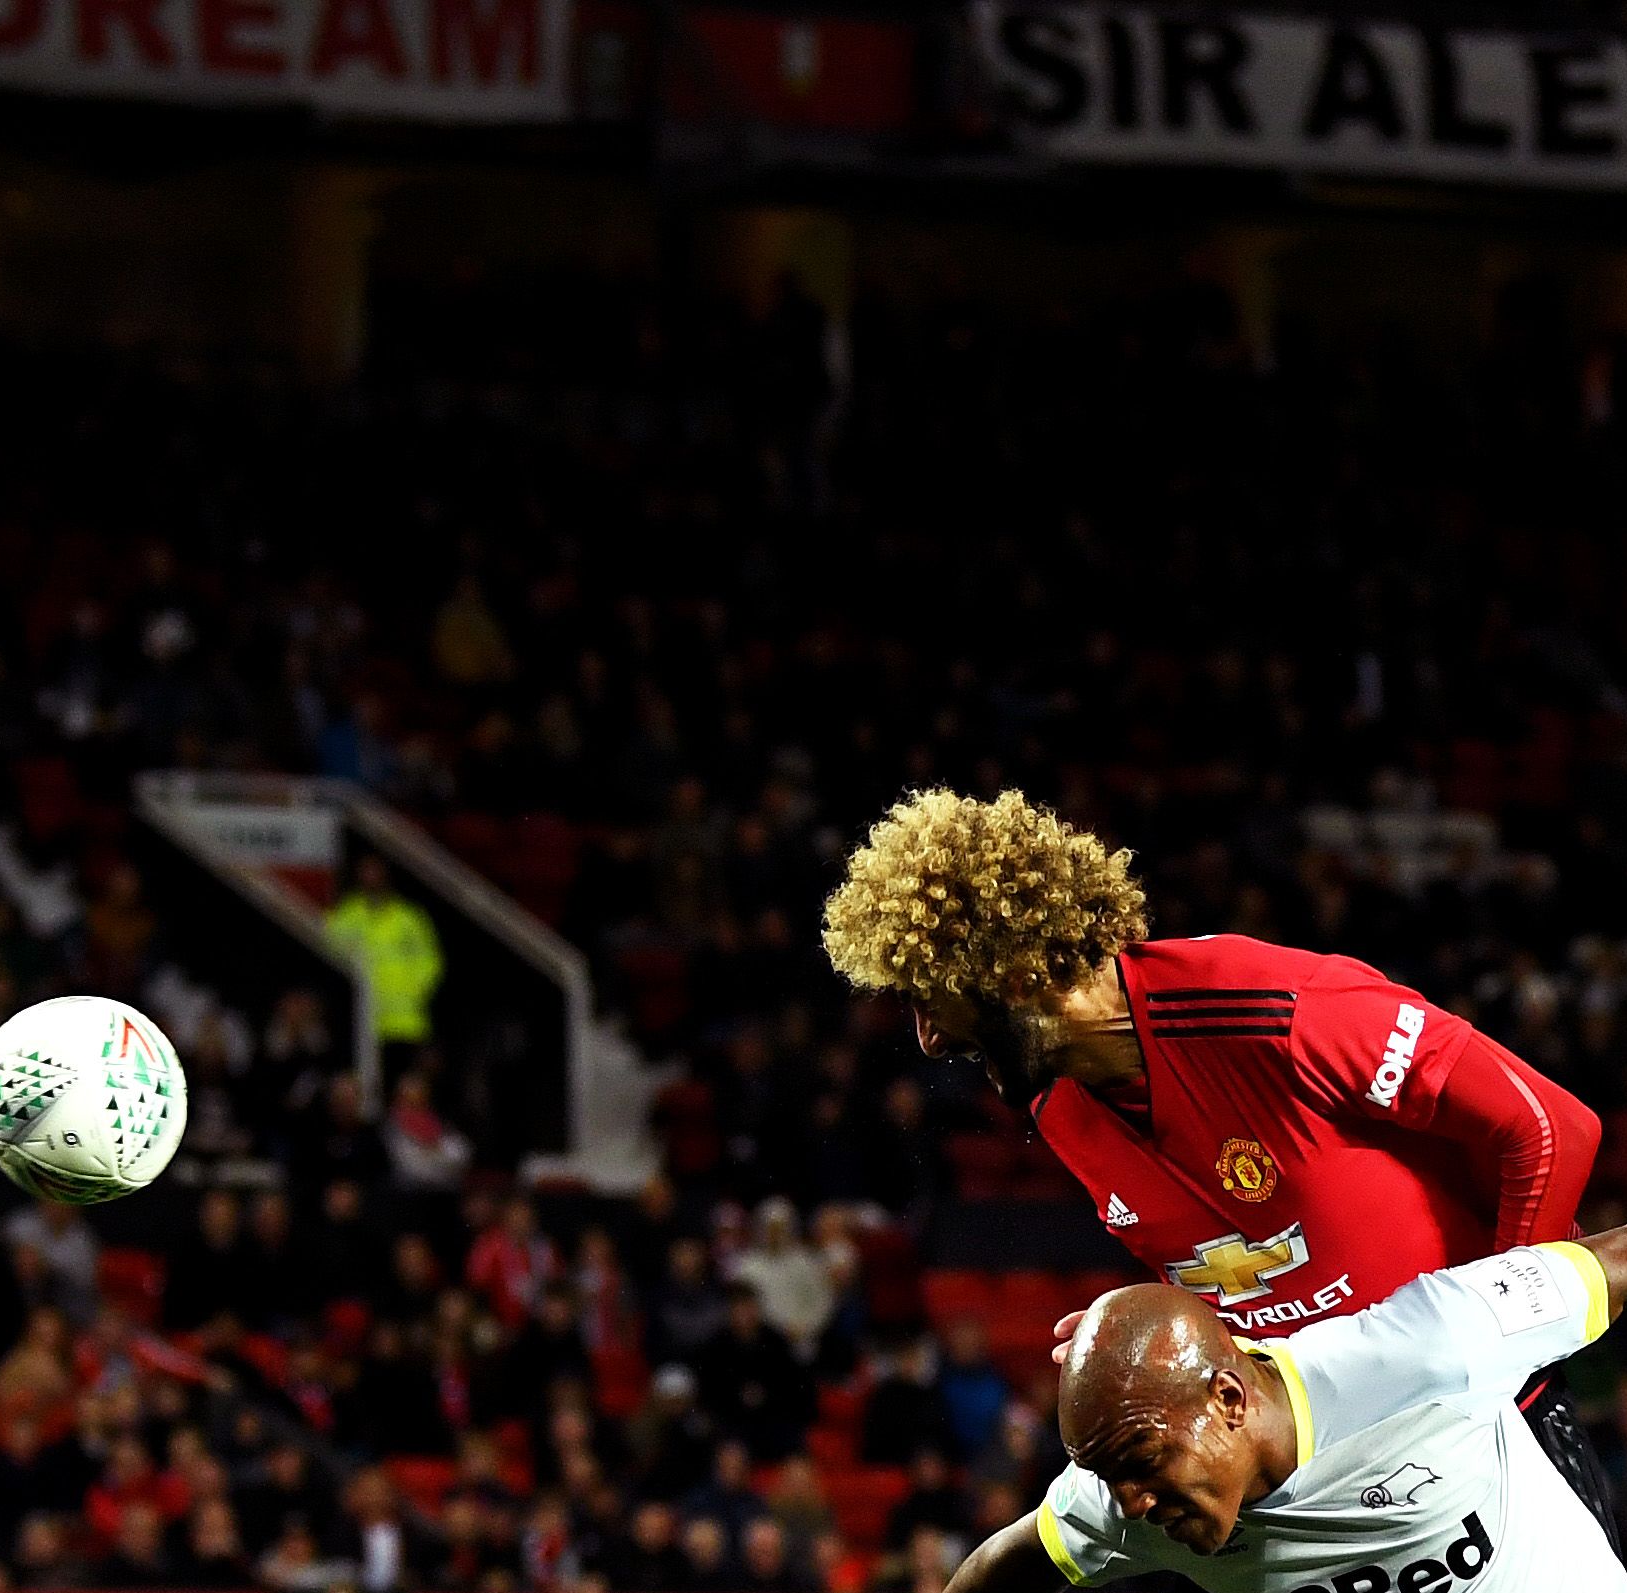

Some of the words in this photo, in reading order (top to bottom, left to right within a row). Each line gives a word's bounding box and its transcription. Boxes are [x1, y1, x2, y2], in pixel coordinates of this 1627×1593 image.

[1000, 12, 1254, 132] SIR
[1364, 1003, 1425, 1108] KOHLER
[1216, 1273, 1354, 1330] VROLET
